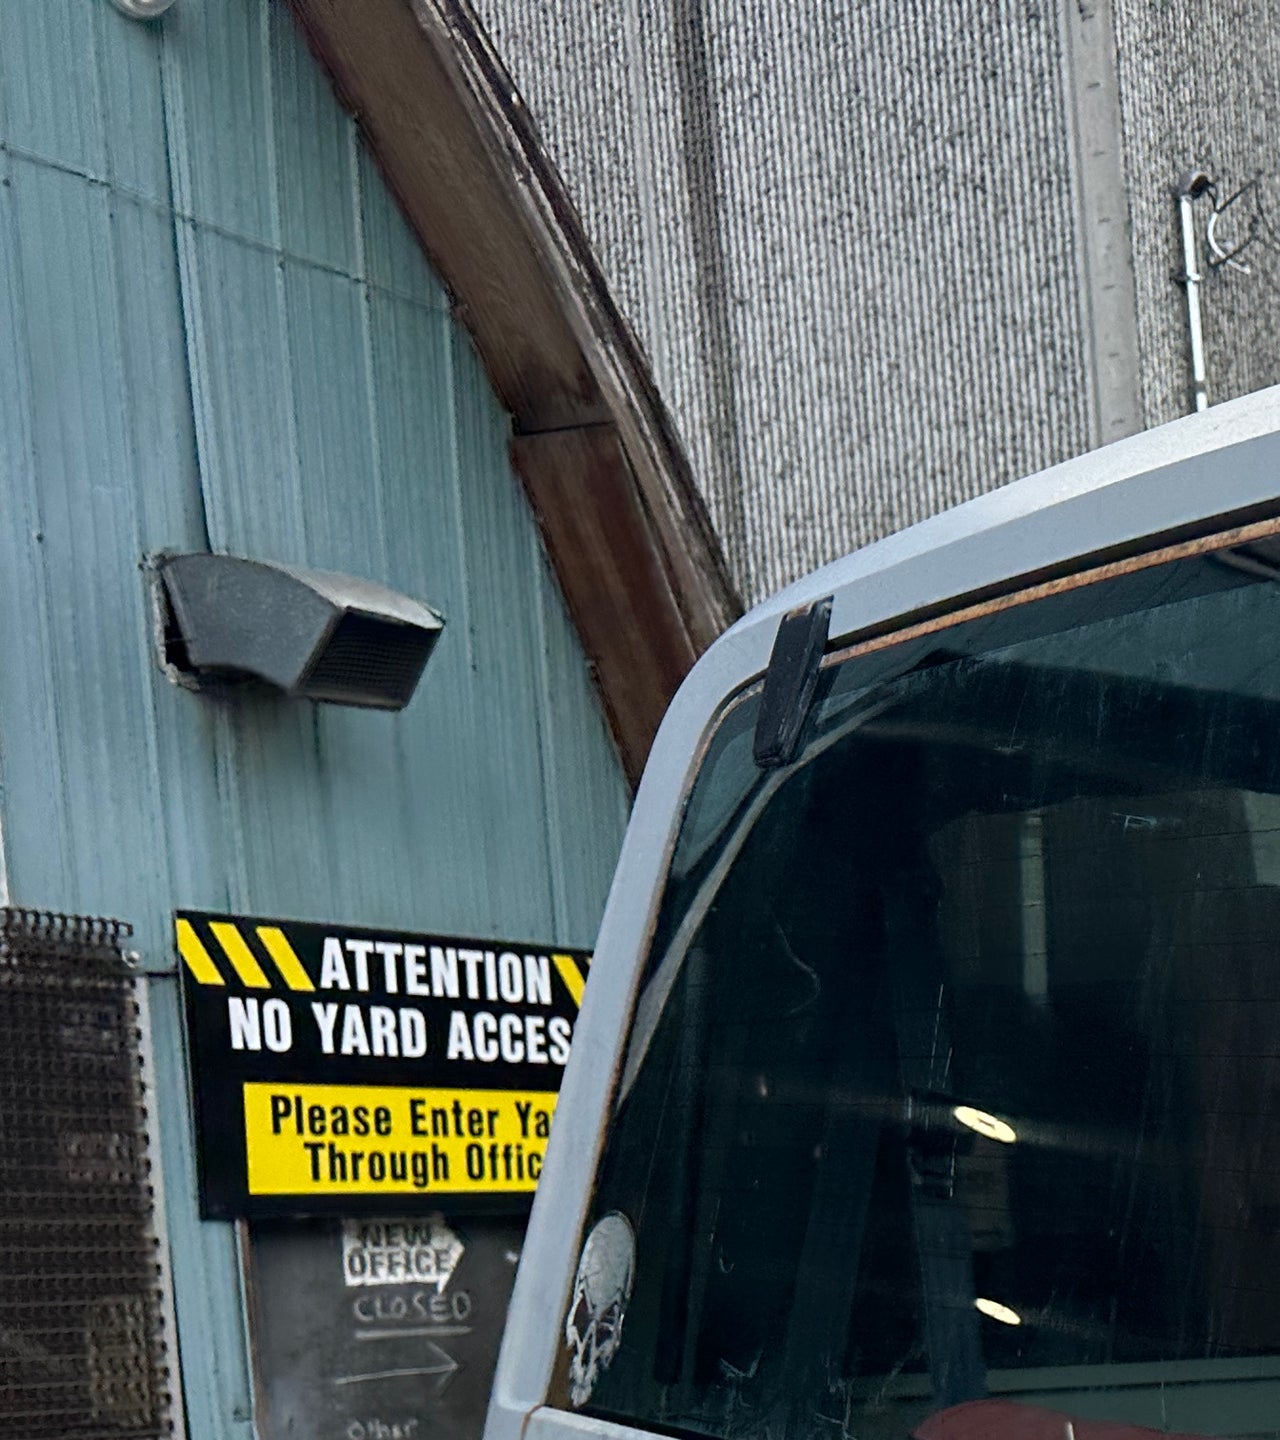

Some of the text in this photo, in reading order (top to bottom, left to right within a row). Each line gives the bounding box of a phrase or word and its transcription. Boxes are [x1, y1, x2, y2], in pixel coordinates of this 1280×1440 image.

[320, 937, 552, 1006] ATTENTION
[228, 997, 571, 1066] NO YARD ACCES
[270, 1095, 555, 1138] Please Enter Ya
[304, 1143, 542, 1187] Through Offic
[359, 1223, 432, 1247] NEW
[349, 1250, 451, 1276] OFFICE
[354, 1291, 472, 1321] CLOSED
